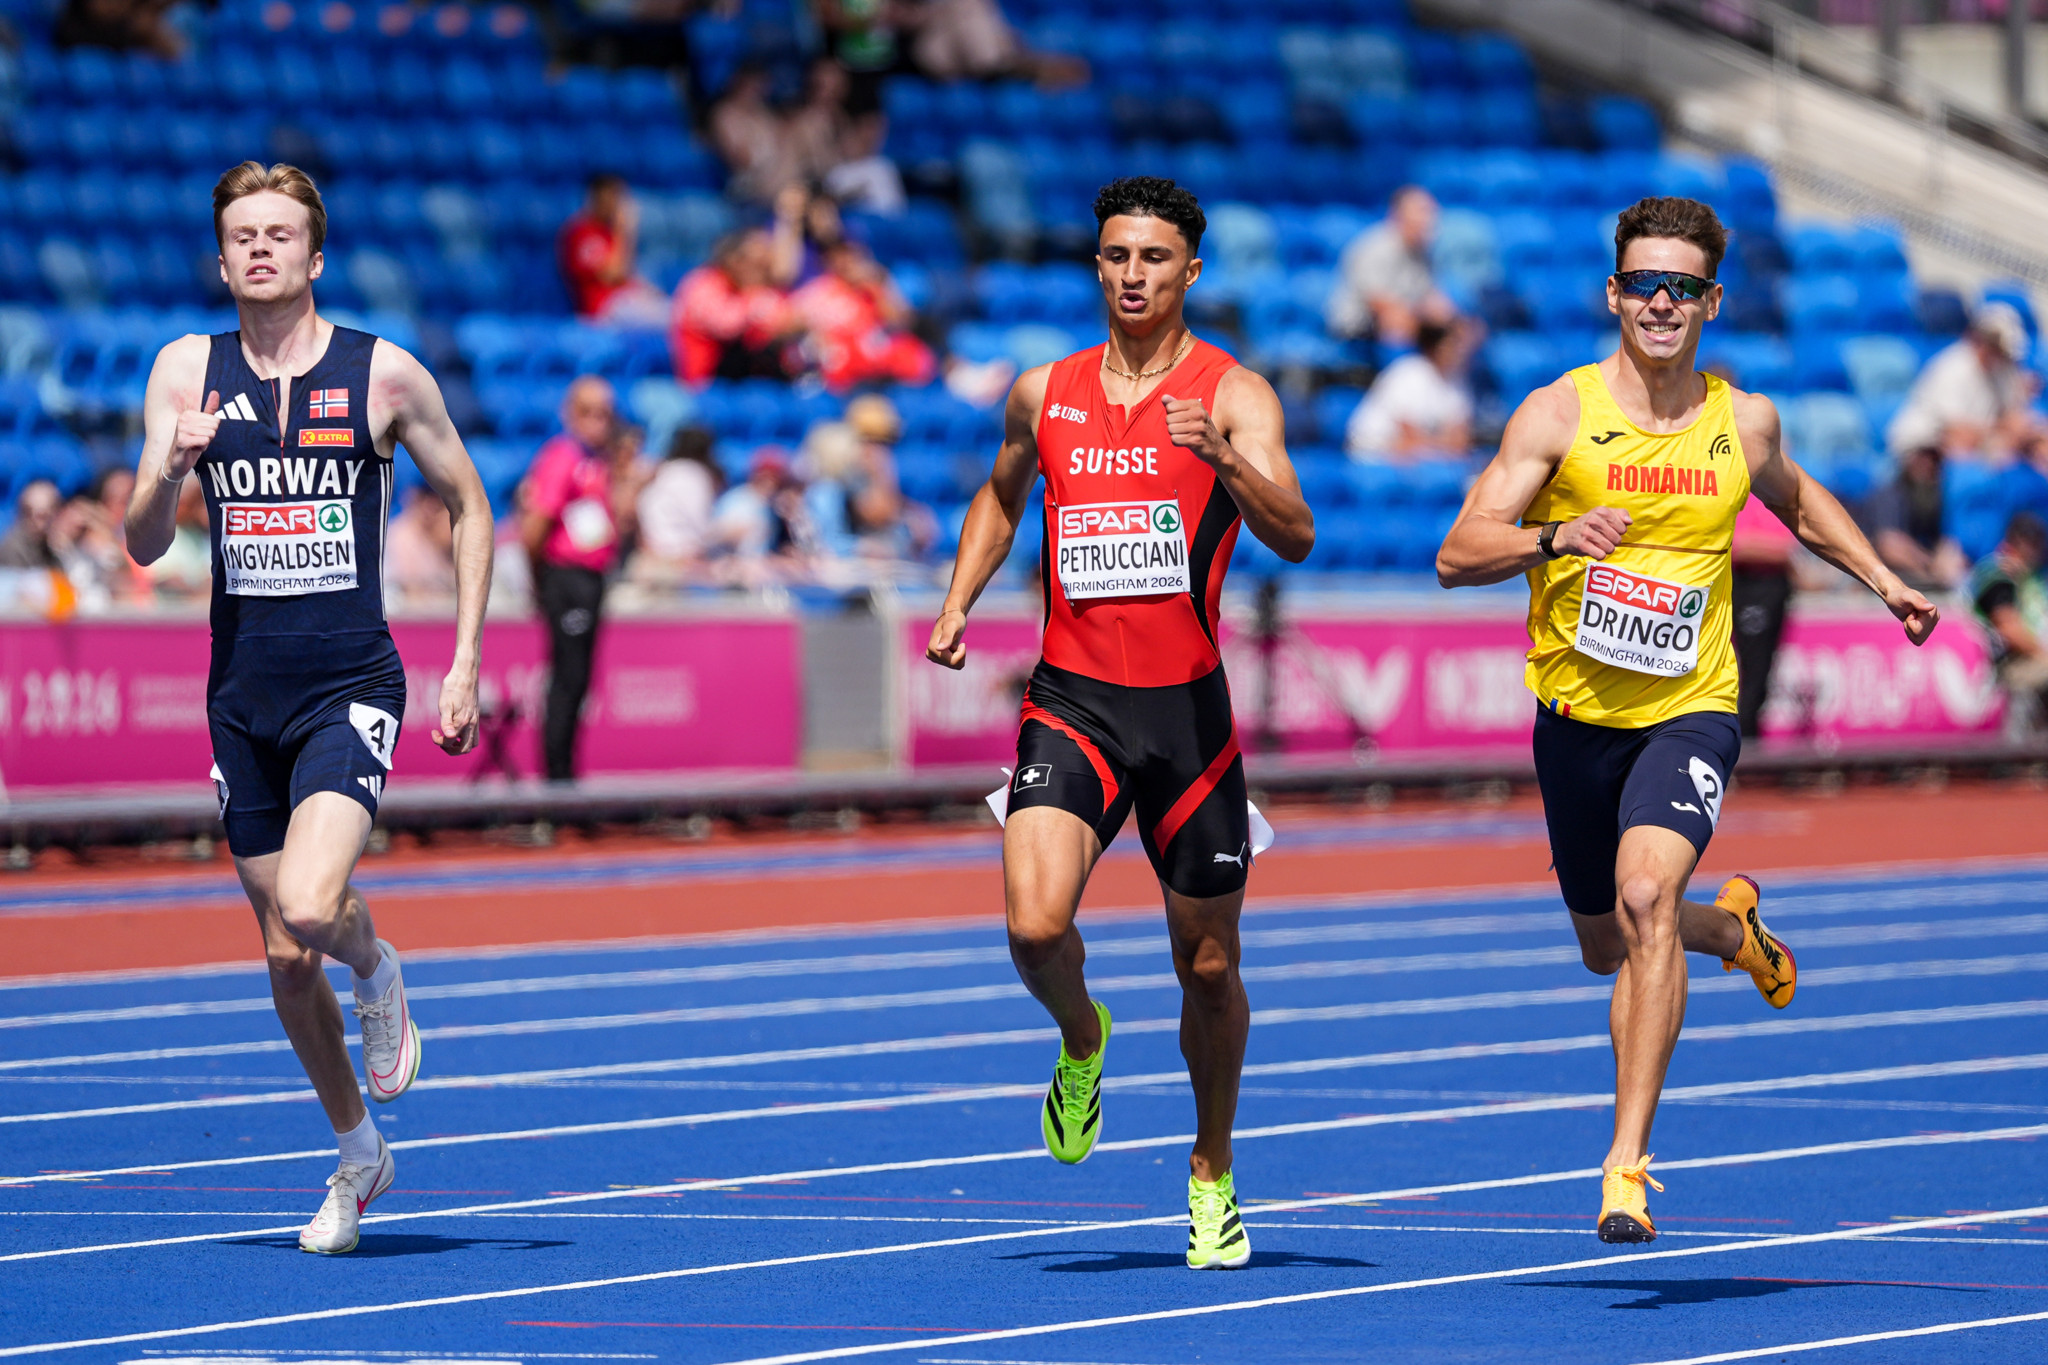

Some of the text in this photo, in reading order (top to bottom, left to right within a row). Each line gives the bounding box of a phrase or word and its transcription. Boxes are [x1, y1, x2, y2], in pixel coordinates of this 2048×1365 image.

[1060, 405, 1088, 424] UBS
[318, 433, 350, 442] EXTRA
[207, 457, 365, 498] NORWAY
[1606, 463, 1719, 497] ROMÂNIA
[228, 507, 314, 532] SPAR
[1063, 508, 1149, 535] SPAR
[223, 539, 351, 571] INGVALDSEN
[1060, 539, 1185, 574] PETRUCCIANI
[231, 573, 351, 590] BIRMINGHAM 2026
[1063, 575, 1183, 593] BIRMINGHAM 2026
[1589, 570, 1679, 612] SPAR
[1583, 600, 1695, 652] DRINGO
[1579, 635, 1690, 673] BIRMINGHAM 2026
[369, 717, 386, 754] 4
[1702, 773, 1719, 816] 2
